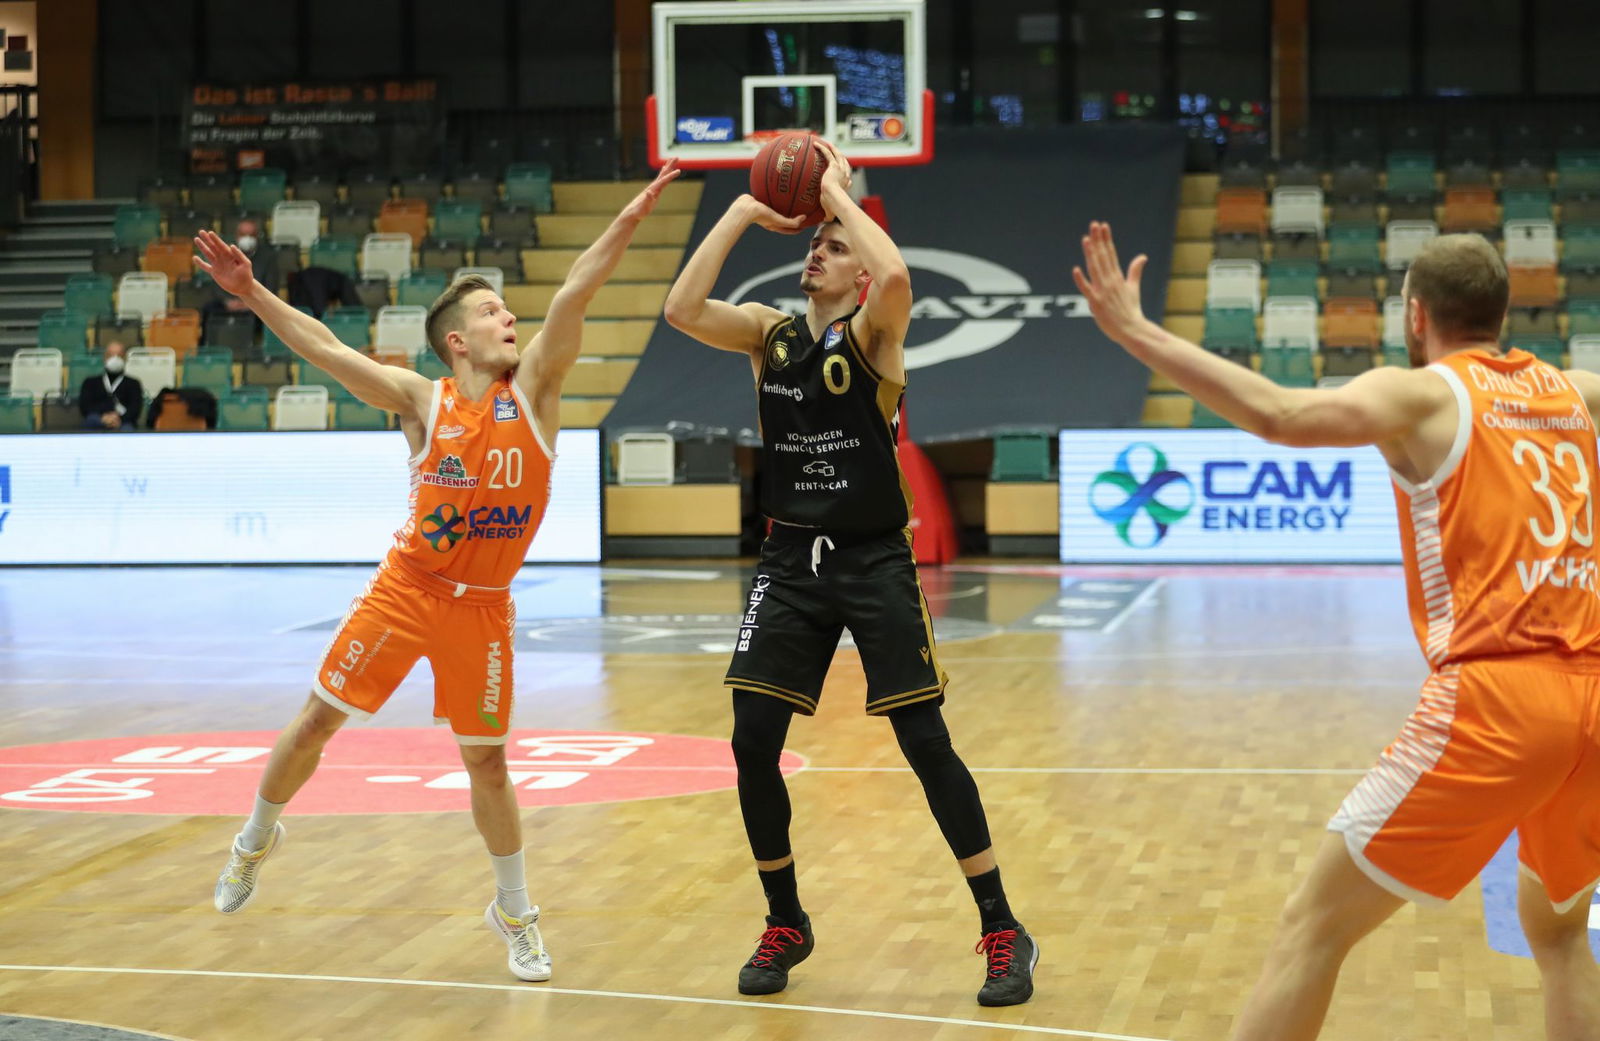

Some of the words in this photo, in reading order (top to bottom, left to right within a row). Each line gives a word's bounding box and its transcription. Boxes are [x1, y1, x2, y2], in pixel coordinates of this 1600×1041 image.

[194, 85, 238, 105] Das
[823, 354, 851, 395] 0
[497, 410, 516, 419] BBL
[1492, 396, 1529, 413] ALTE
[1482, 412, 1584, 430] OLDENBURGER
[816, 438, 861, 454] SERVICES
[487, 447, 523, 489] 20
[1203, 461, 1352, 499] CAM
[1513, 440, 1594, 547] 33
[1203, 506, 1350, 530] ENERGY
[340, 639, 365, 671] LzO
